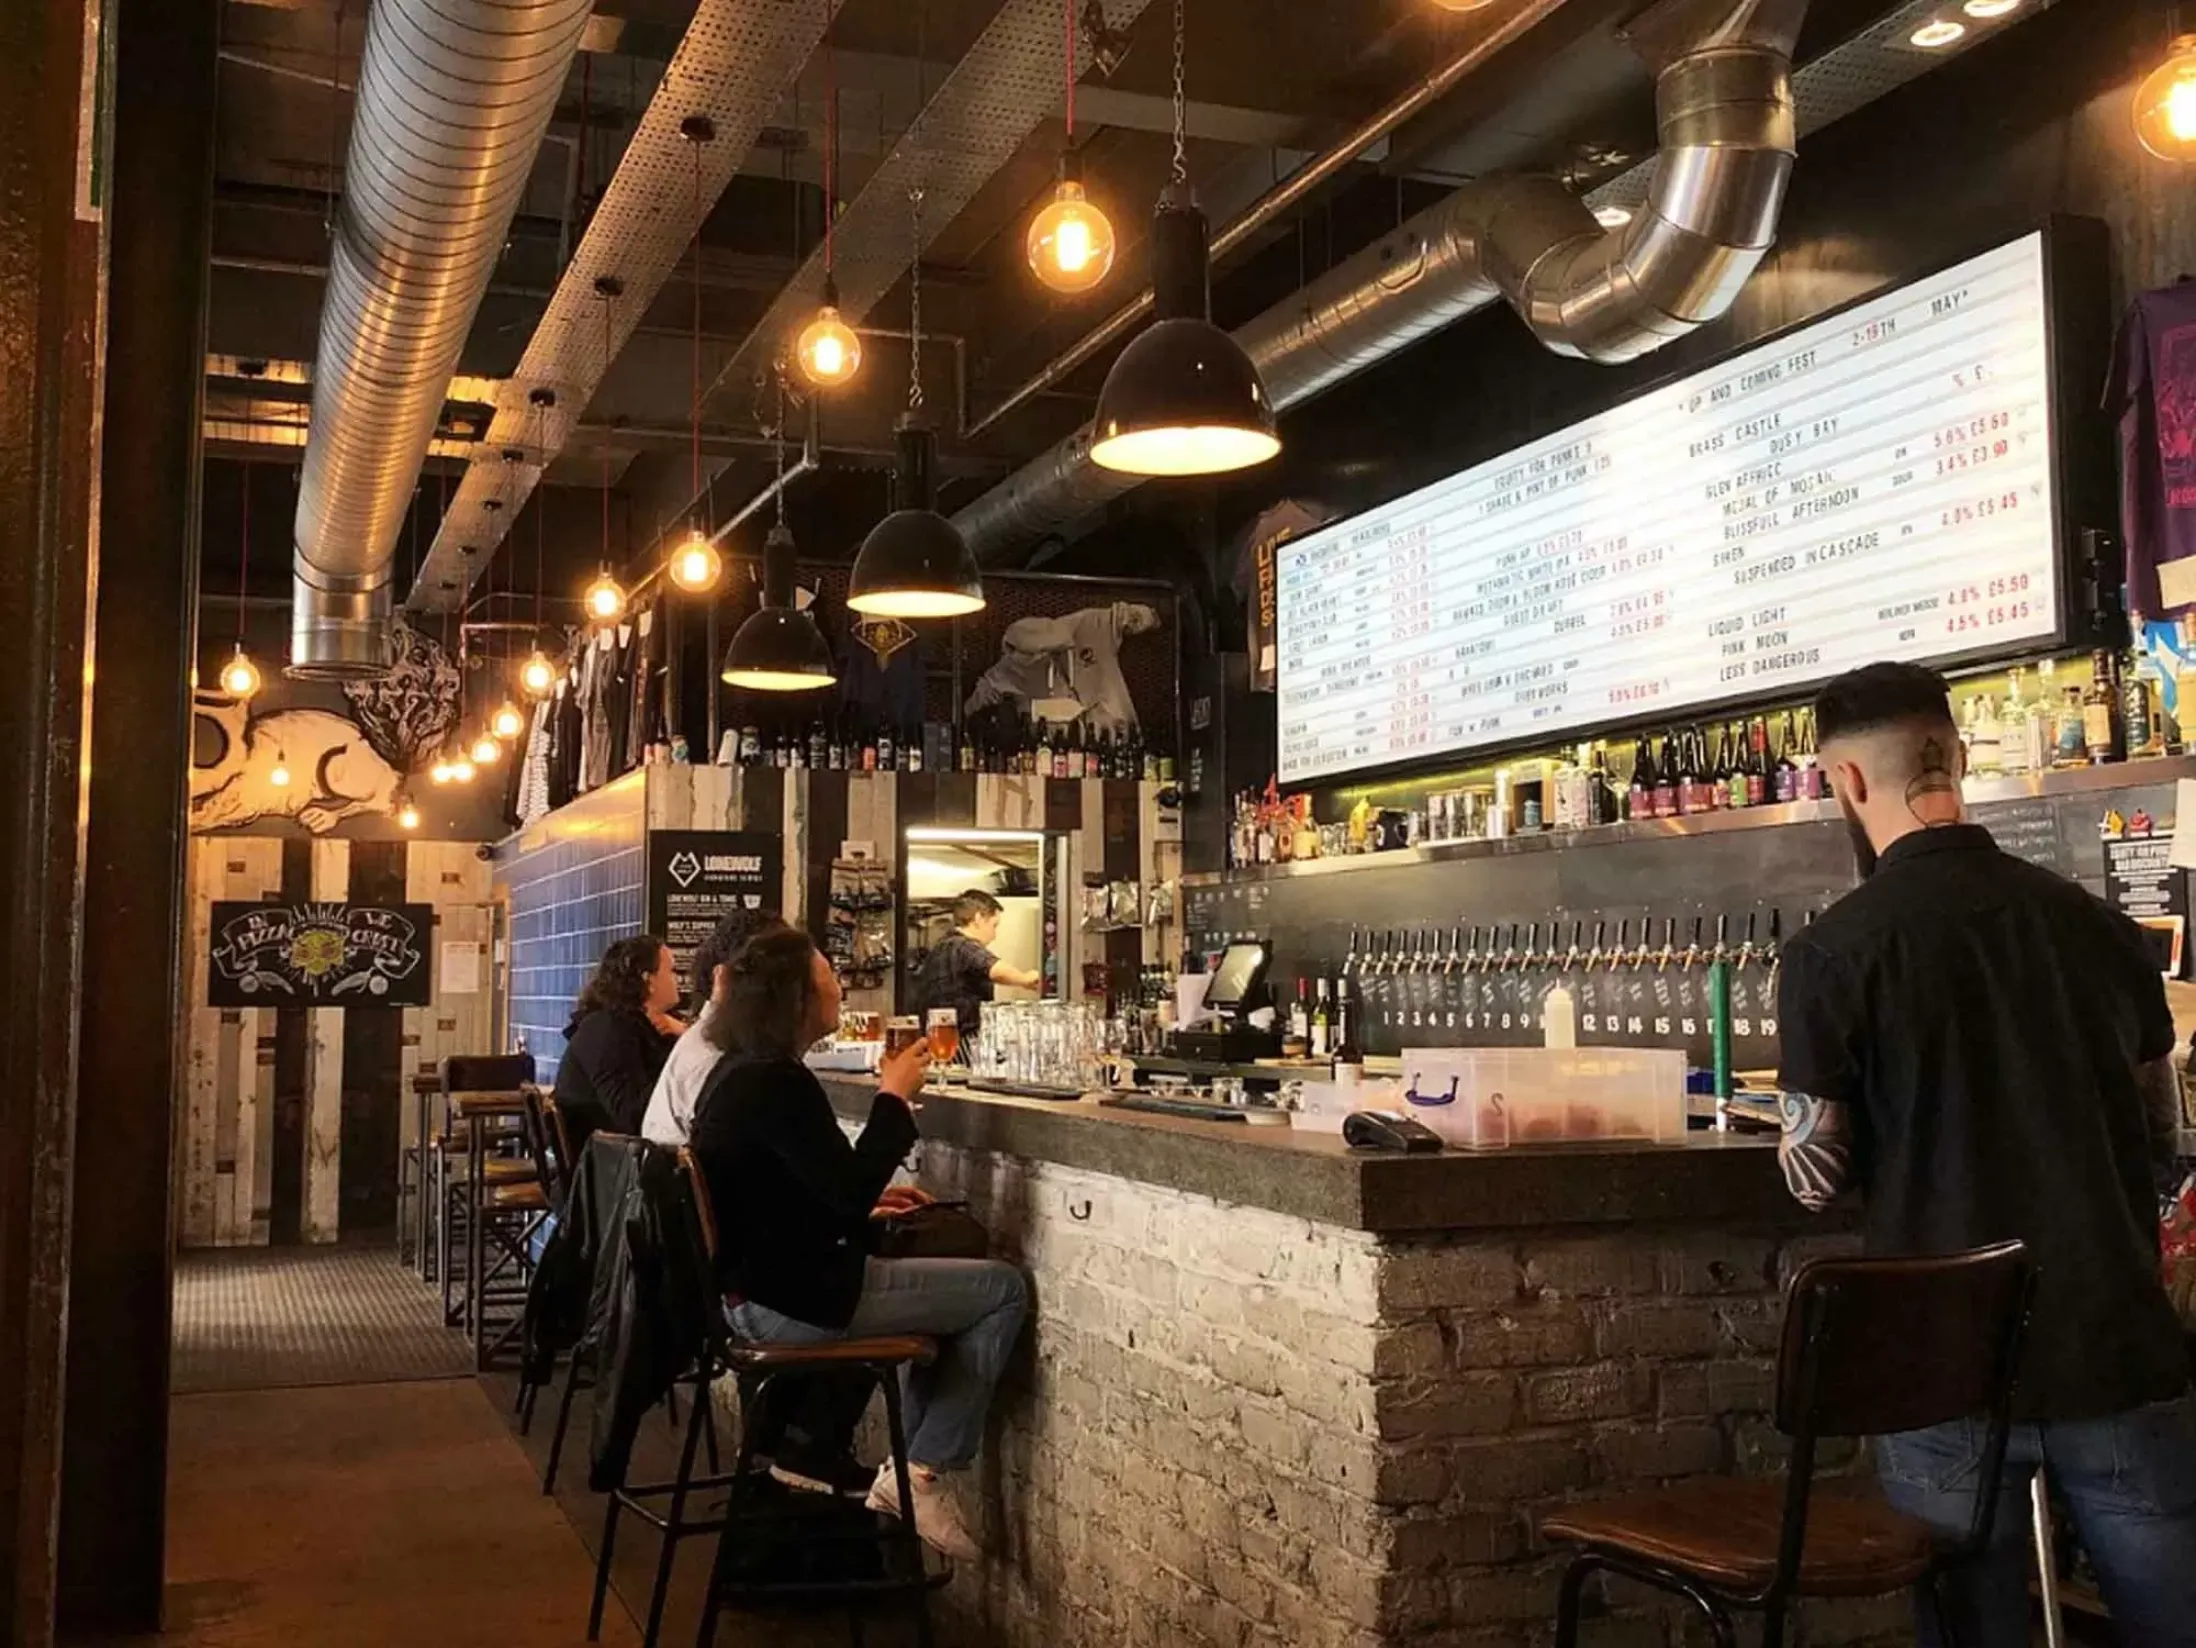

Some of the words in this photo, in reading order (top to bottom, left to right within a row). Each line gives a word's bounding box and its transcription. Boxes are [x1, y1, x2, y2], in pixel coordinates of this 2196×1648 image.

[1710, 384, 1731, 404] AND
[1741, 364, 1780, 392] COMING
[1788, 350, 1814, 373] FEST
[1689, 432, 1724, 459] BRASS
[1736, 411, 1780, 442] CASTLE
[1813, 415, 1838, 439] BAY
[1705, 478, 1730, 500] GLEN
[1792, 484, 1859, 519] AFTERNOON
[1712, 544, 1744, 568] SIREN
[1733, 553, 1796, 585] SUSPENDED
[1818, 529, 1880, 562] CASCADE
[1708, 614, 1744, 638] LIQUID
[1752, 604, 1788, 627] LIGHT
[1721, 639, 1745, 658] PINK
[1756, 628, 1788, 650] MOON
[1987, 571, 2030, 599] £5.50
[1719, 663, 1745, 683] LESS
[1752, 647, 1820, 675] DANGEROUS
[1944, 613, 1980, 636] 4.5%
[1986, 602, 2029, 627] £5.45
[1383, 1011, 1389, 1025] 1
[1397, 1012, 1405, 1026] 2
[1412, 1012, 1422, 1027] 3
[1428, 1012, 1437, 1026] 4
[1446, 1013, 1455, 1027] 5
[1465, 1013, 1474, 1028] 6
[1482, 1013, 1491, 1028] 7
[1501, 1013, 1511, 1029] 8
[1520, 1013, 1530, 1028] 9
[1582, 1014, 1596, 1031] 12
[1607, 1015, 1620, 1032] 13
[1628, 1016, 1643, 1034] 14
[1655, 1017, 1670, 1034] 15
[1682, 1018, 1695, 1034] 16
[1734, 1019, 1750, 1036] 18
[1761, 1019, 1778, 1036] 19
